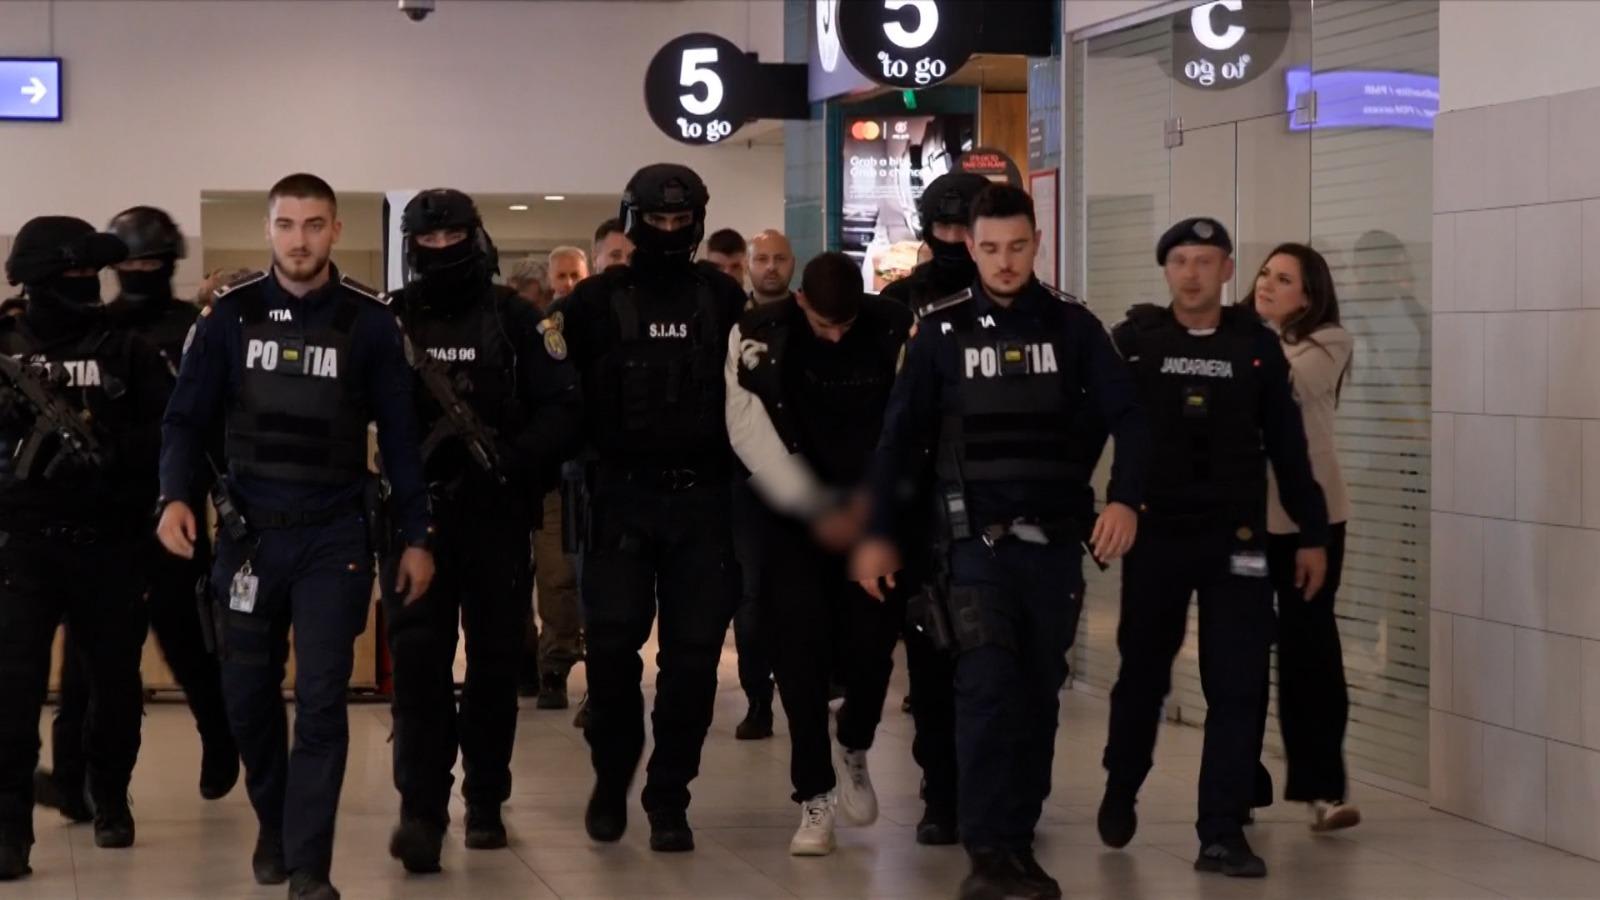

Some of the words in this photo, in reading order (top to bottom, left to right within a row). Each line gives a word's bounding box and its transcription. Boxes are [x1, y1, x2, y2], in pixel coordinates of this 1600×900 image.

[883, 0, 939, 48] 5
[679, 47, 723, 115] 5
[915, 57, 946, 84] go
[707, 119, 731, 142] go
[879, 158, 888, 167] a
[879, 169, 887, 177] a
[246, 338, 338, 378] POTIA
[964, 342, 1058, 379] POIA
